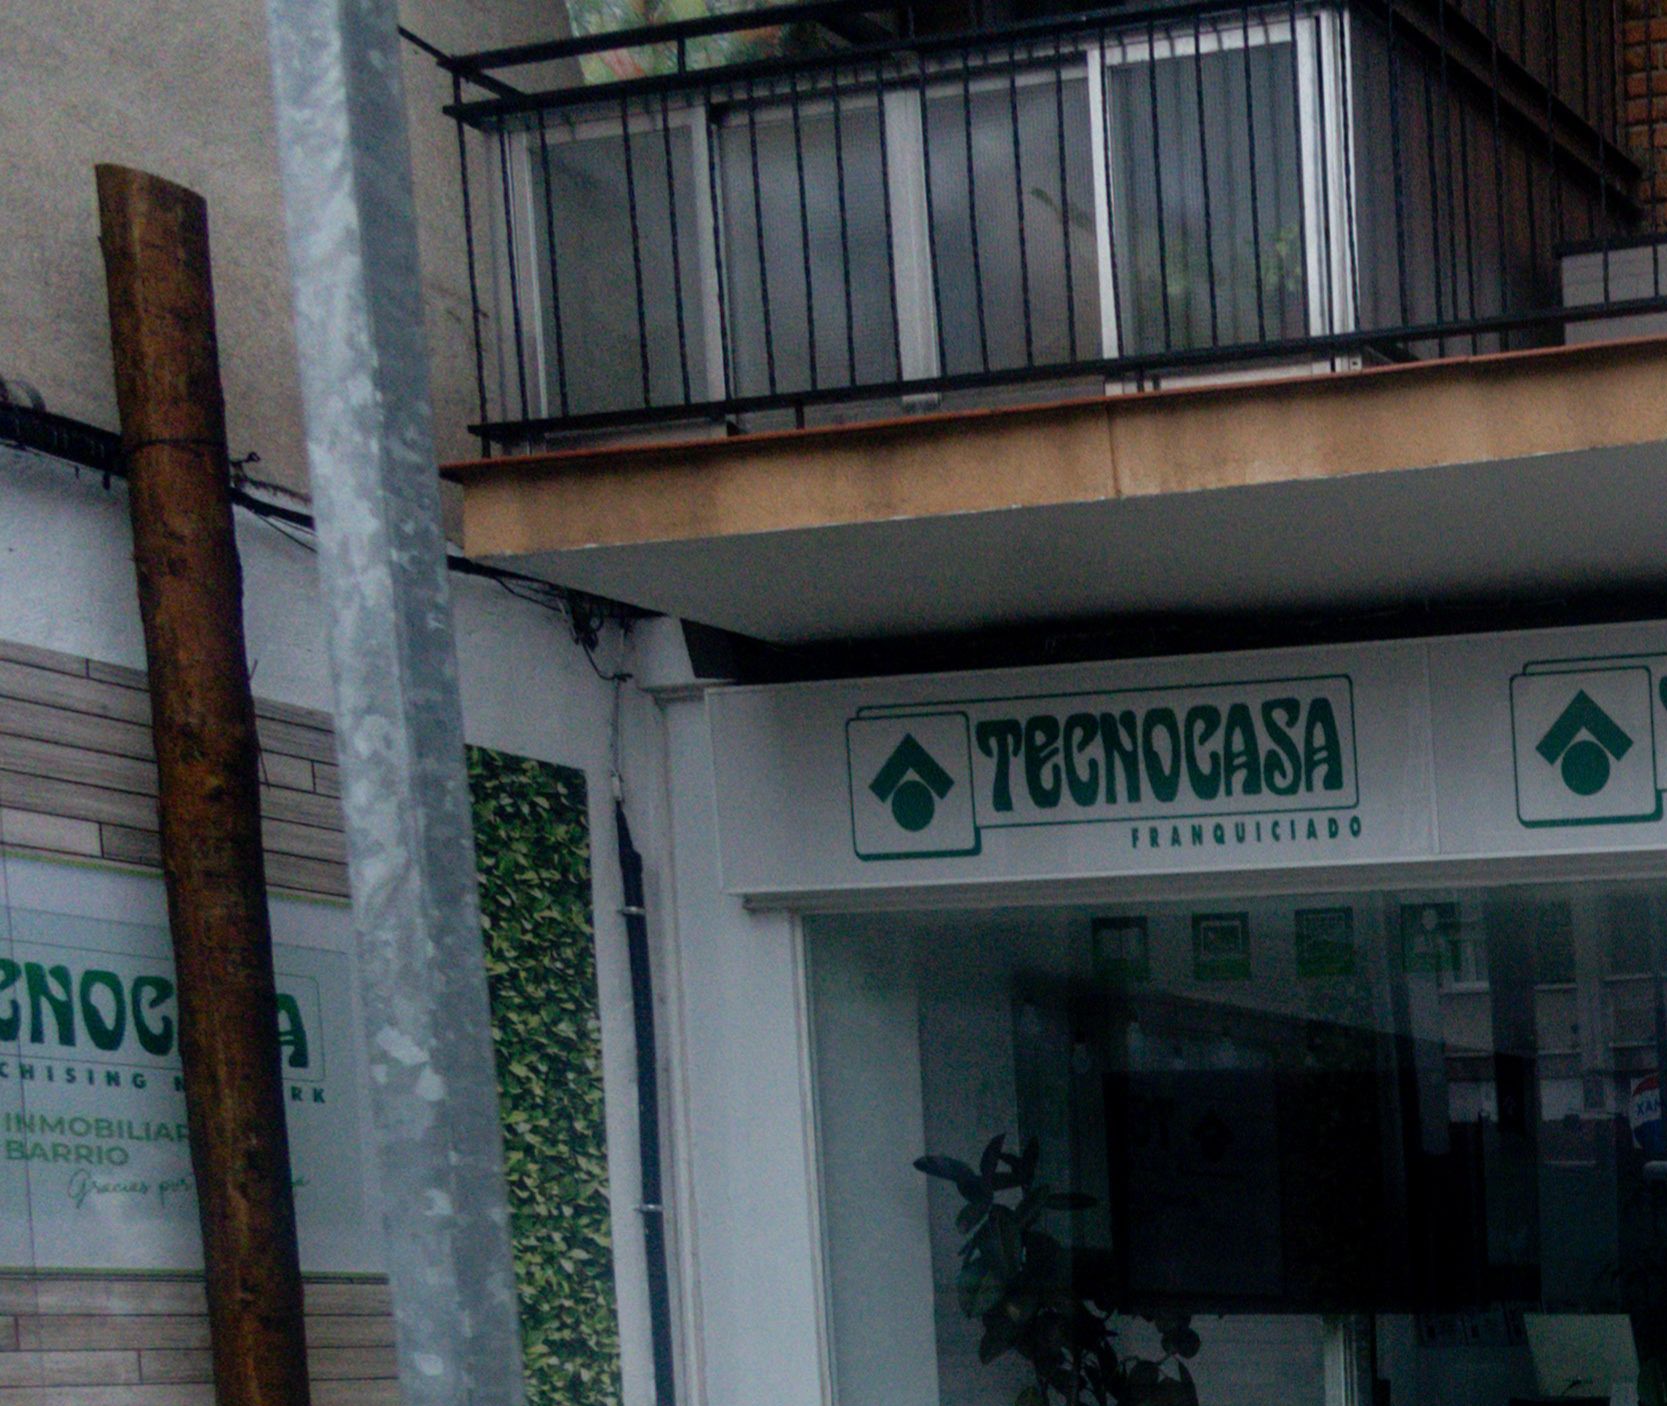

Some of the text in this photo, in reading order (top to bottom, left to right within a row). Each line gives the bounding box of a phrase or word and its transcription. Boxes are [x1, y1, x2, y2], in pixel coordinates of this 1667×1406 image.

[976, 697, 1344, 812] TECNOCASA
[1131, 815, 1363, 849] FRANQUICIADO
[4, 1139, 129, 1166] BARRIO
